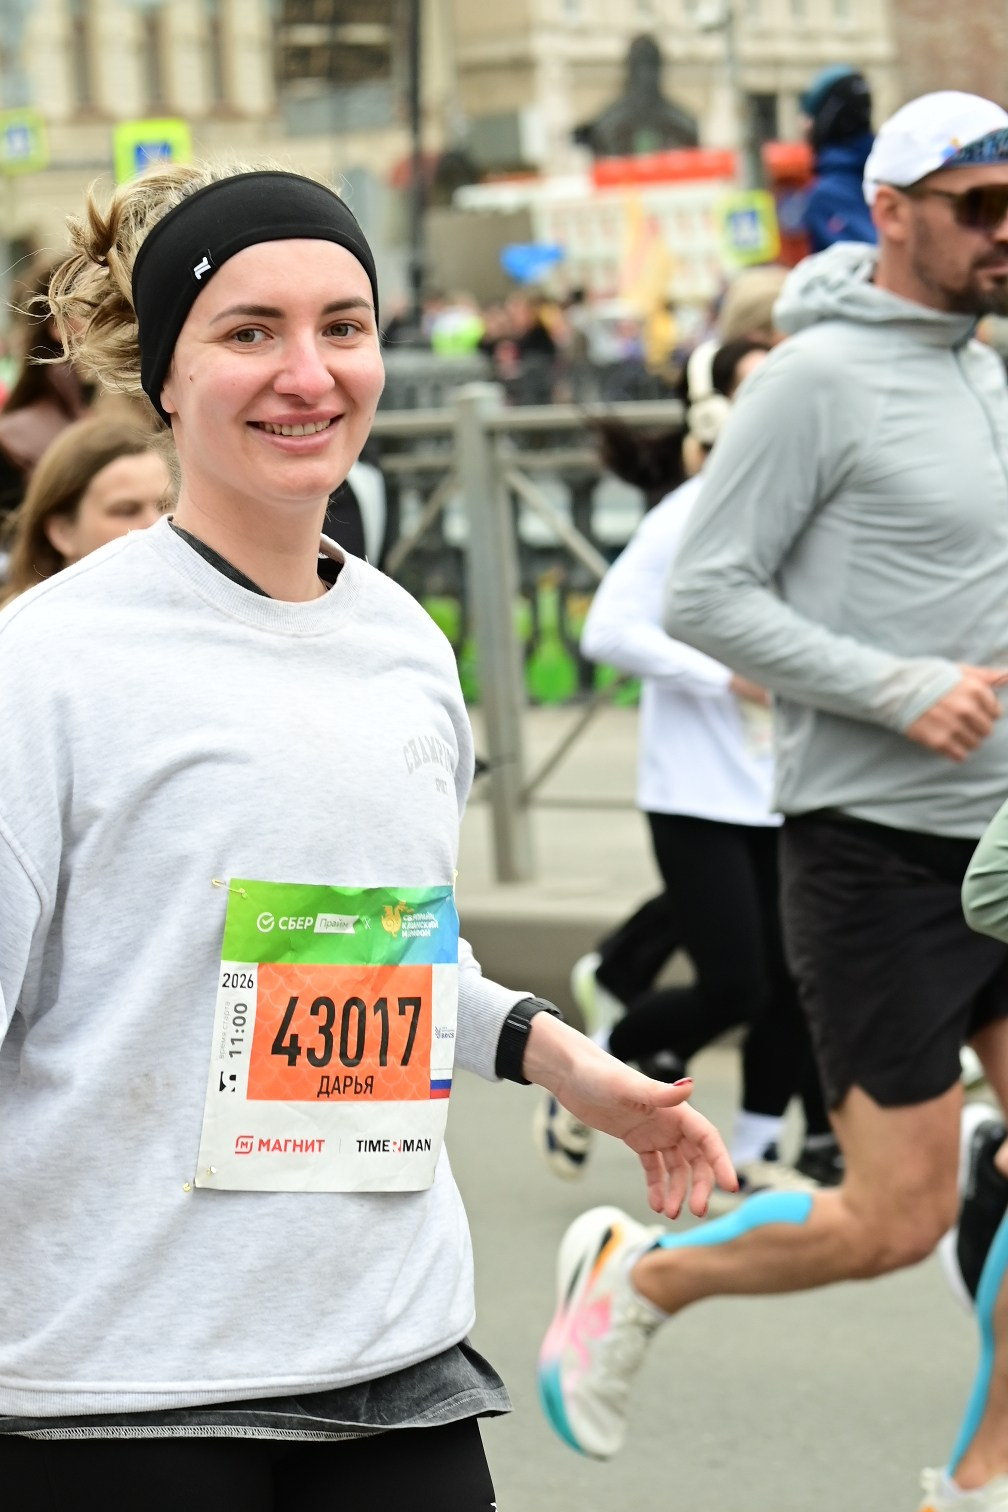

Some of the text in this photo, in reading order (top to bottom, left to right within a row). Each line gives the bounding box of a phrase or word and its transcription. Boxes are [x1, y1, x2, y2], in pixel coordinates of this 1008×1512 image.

[278, 915, 314, 930] СБЕР
[319, 917, 350, 930] Прайм
[222, 973, 254, 989] 2026
[229, 1002, 248, 1058] 11:00
[271, 996, 422, 1068] 43017
[317, 1075, 374, 1097] ДАРЬЯ
[258, 1139, 325, 1152] МАГНИТ
